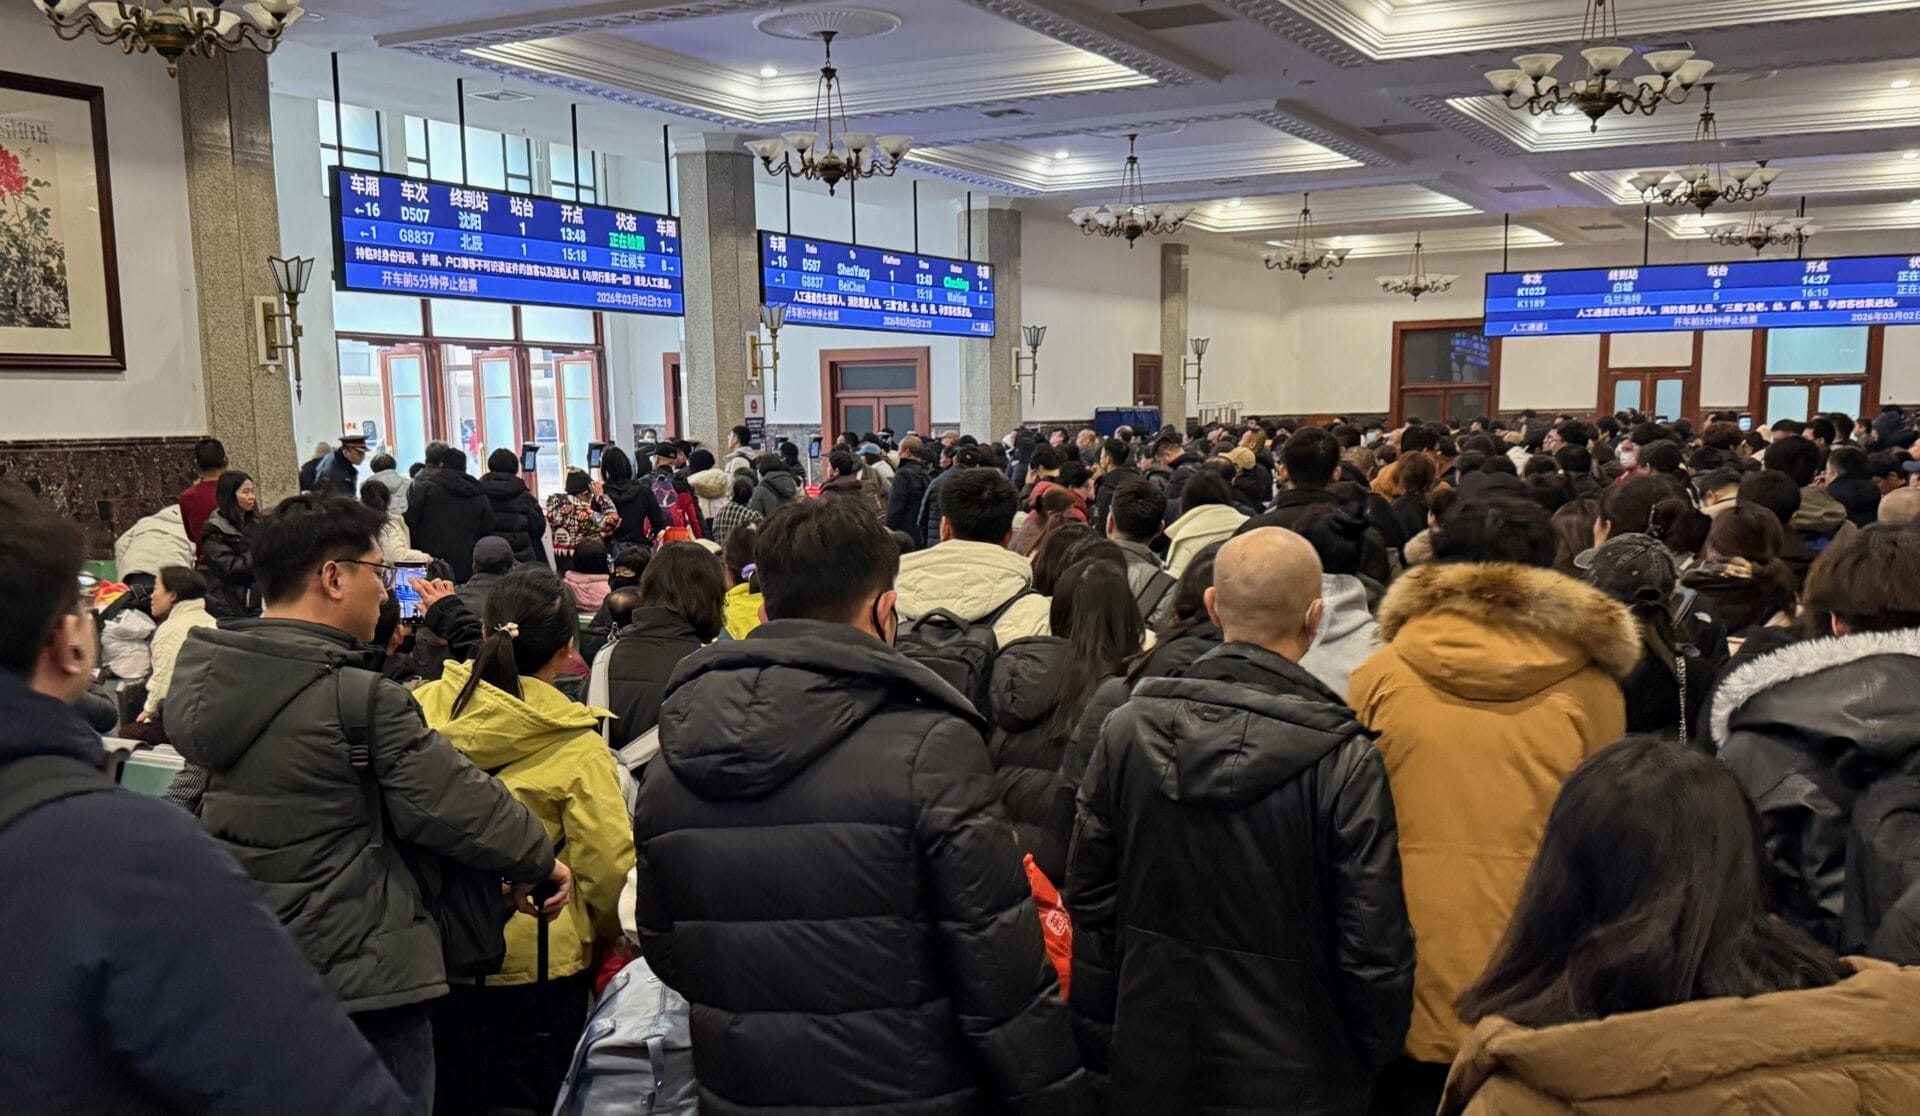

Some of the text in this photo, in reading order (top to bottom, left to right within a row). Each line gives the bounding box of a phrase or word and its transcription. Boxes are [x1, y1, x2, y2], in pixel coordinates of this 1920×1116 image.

[351, 174, 676, 238] 车厢 车次 终到站 站台 开点 状态 车厢
[365, 202, 665, 253] 16 D507 沈阳 1 13:48 正在检票 1
[370, 226, 377, 239] 1
[399, 229, 435, 245] G8837
[460, 234, 483, 251] 北辰
[521, 243, 527, 256] 1
[562, 248, 587, 262] 15:18
[610, 252, 646, 271] 正在候车
[381, 271, 478, 293] 开车前5分钟停止检票
[777, 255, 788, 268] 16
[802, 258, 821, 272] D507
[837, 262, 870, 281] ShenYang
[889, 269, 895, 282] 1
[978, 280, 983, 291] 1
[780, 273, 786, 284] 1
[838, 279, 866, 293] BeiChen
[890, 285, 895, 297] 1
[1522, 273, 1543, 285] 车次
[1608, 268, 1639, 281] 终到站
[1707, 265, 1729, 277] 站台
[1805, 260, 1828, 273] 开点
[1517, 285, 1547, 297] K1023
[1613, 281, 1634, 293] 白城
[1713, 278, 1721, 289] 5
[1801, 274, 1831, 285] 14:37
[1517, 283, 1920, 308] K1189 乌兰浩特 5 16:10 正在
[1511, 321, 1545, 333] 人工通道
[1673, 315, 1758, 328] 开车前5分钟停止检票
